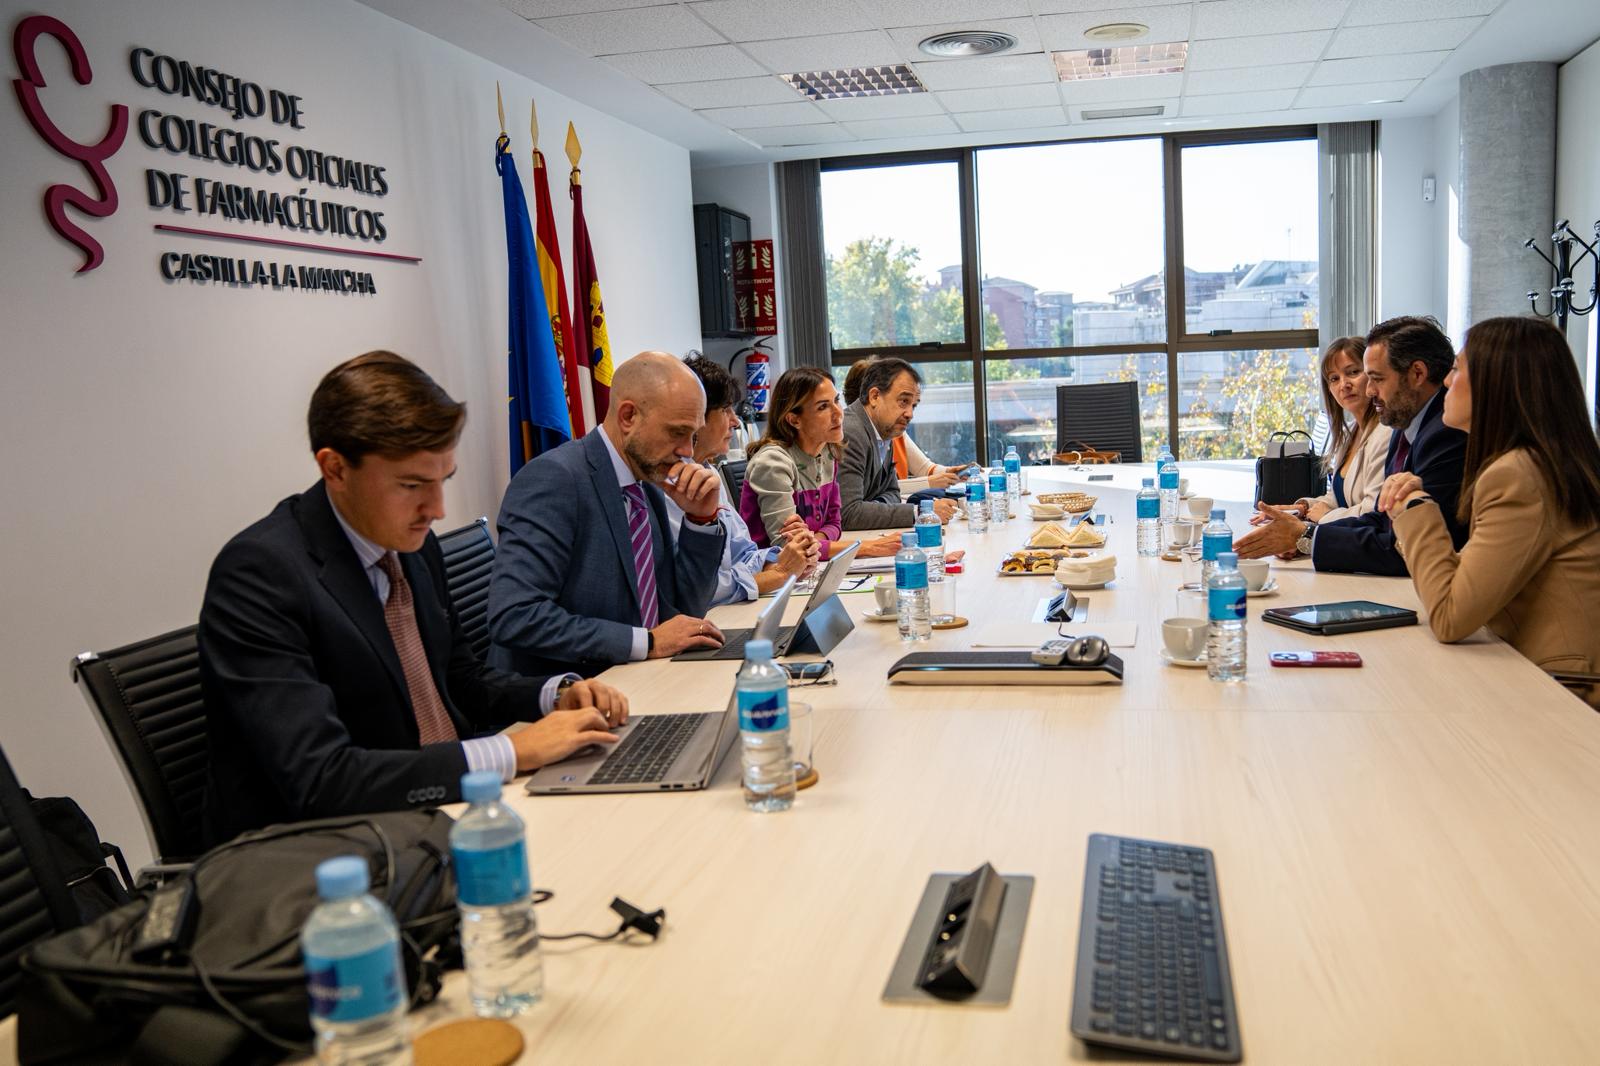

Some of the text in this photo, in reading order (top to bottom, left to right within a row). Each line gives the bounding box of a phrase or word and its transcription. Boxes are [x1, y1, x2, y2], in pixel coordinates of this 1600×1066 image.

[130, 47, 306, 130] CONSEJO DE
[138, 109, 389, 196] COLEGIOS OFICIALES
[146, 168, 387, 242] DE FARMACÉUTICOS
[160, 251, 377, 295] CASTILLA-LA MANCHA
